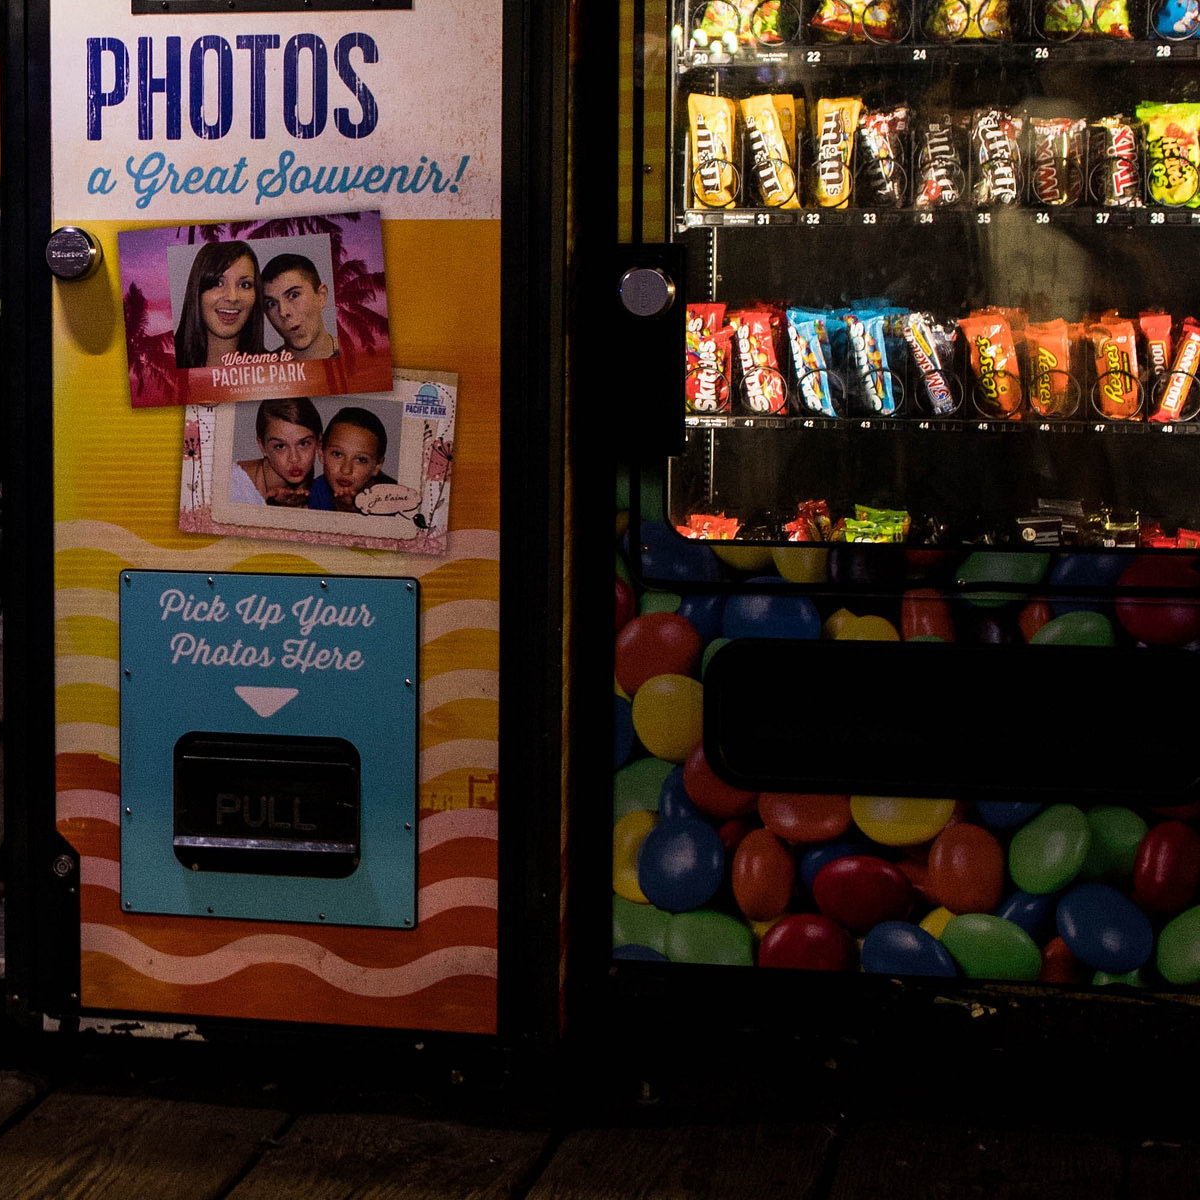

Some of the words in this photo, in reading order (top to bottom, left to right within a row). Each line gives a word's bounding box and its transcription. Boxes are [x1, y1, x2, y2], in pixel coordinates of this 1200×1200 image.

[913, 50, 926, 60] 24
[1036, 48, 1049, 58] 26
[1157, 45, 1171, 57] 28
[695, 53, 708, 64] 20
[807, 52, 821, 62] 22
[86, 32, 379, 142] PHOTOS
[87, 165, 117, 195] a
[125, 151, 249, 210] Great
[254, 150, 471, 206] Souvenir!
[757, 214, 770, 224] 31
[807, 214, 820, 225] 32
[863, 214, 876, 224] 33
[920, 213, 933, 224] 34
[978, 213, 991, 224] 35
[1036, 213, 1049, 223] 36
[1096, 213, 1110, 223] 37
[1151, 213, 1165, 224] 38
[221, 350, 279, 366] Welcome
[280, 349, 294, 361] to
[212, 365, 265, 387] PACIFIC
[269, 362, 306, 383] PARK
[933, 388, 950, 400] 3
[405, 404, 430, 415] PACIFIC
[430, 405, 447, 416] PARK
[744, 419, 754, 427] 41
[804, 420, 814, 428] 42
[860, 421, 871, 429] 43
[978, 423, 988, 431] 45
[1039, 423, 1049, 431] 46
[1162, 425, 1173, 433] 48
[159, 588, 230, 623] Pick
[235, 594, 286, 631] Up
[292, 595, 376, 636] Your
[170, 632, 276, 667] Photos
[281, 638, 365, 674] Here
[216, 792, 318, 833] PULL
